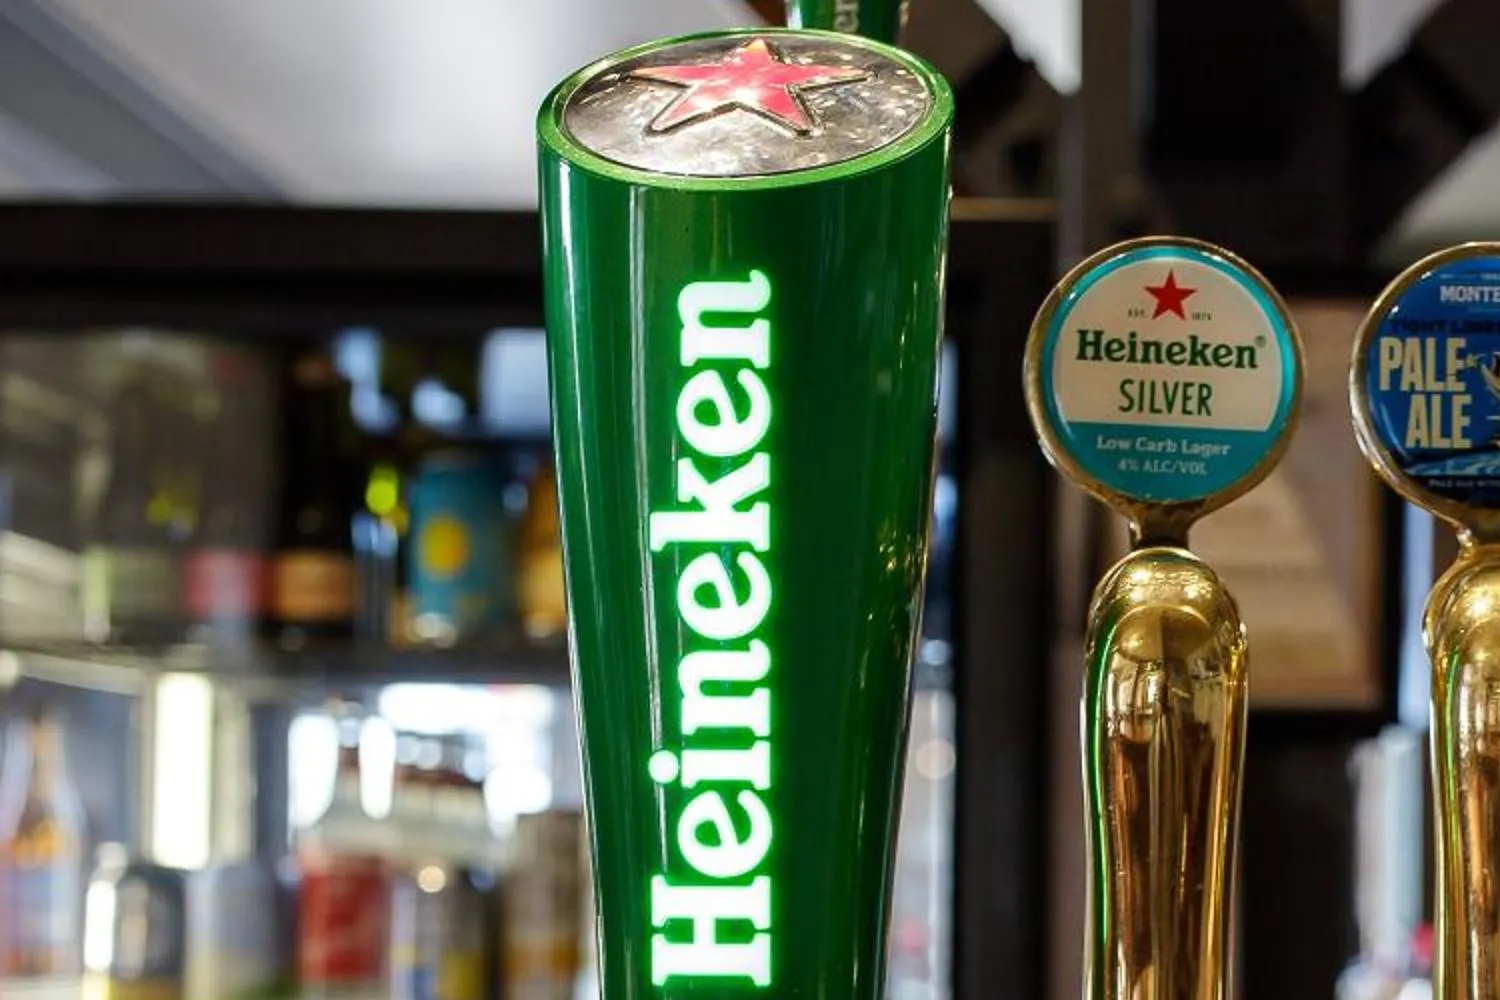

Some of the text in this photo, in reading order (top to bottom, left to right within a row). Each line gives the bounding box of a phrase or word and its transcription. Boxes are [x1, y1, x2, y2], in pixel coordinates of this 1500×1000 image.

[1076, 329, 1259, 369] Heineken
[1379, 337, 1467, 392] PALE
[1118, 379, 1213, 416] SILVER
[1405, 394, 1472, 449] ALE
[1096, 435, 1232, 457] Low Carb Lager
[649, 268, 772, 987] Heineken
